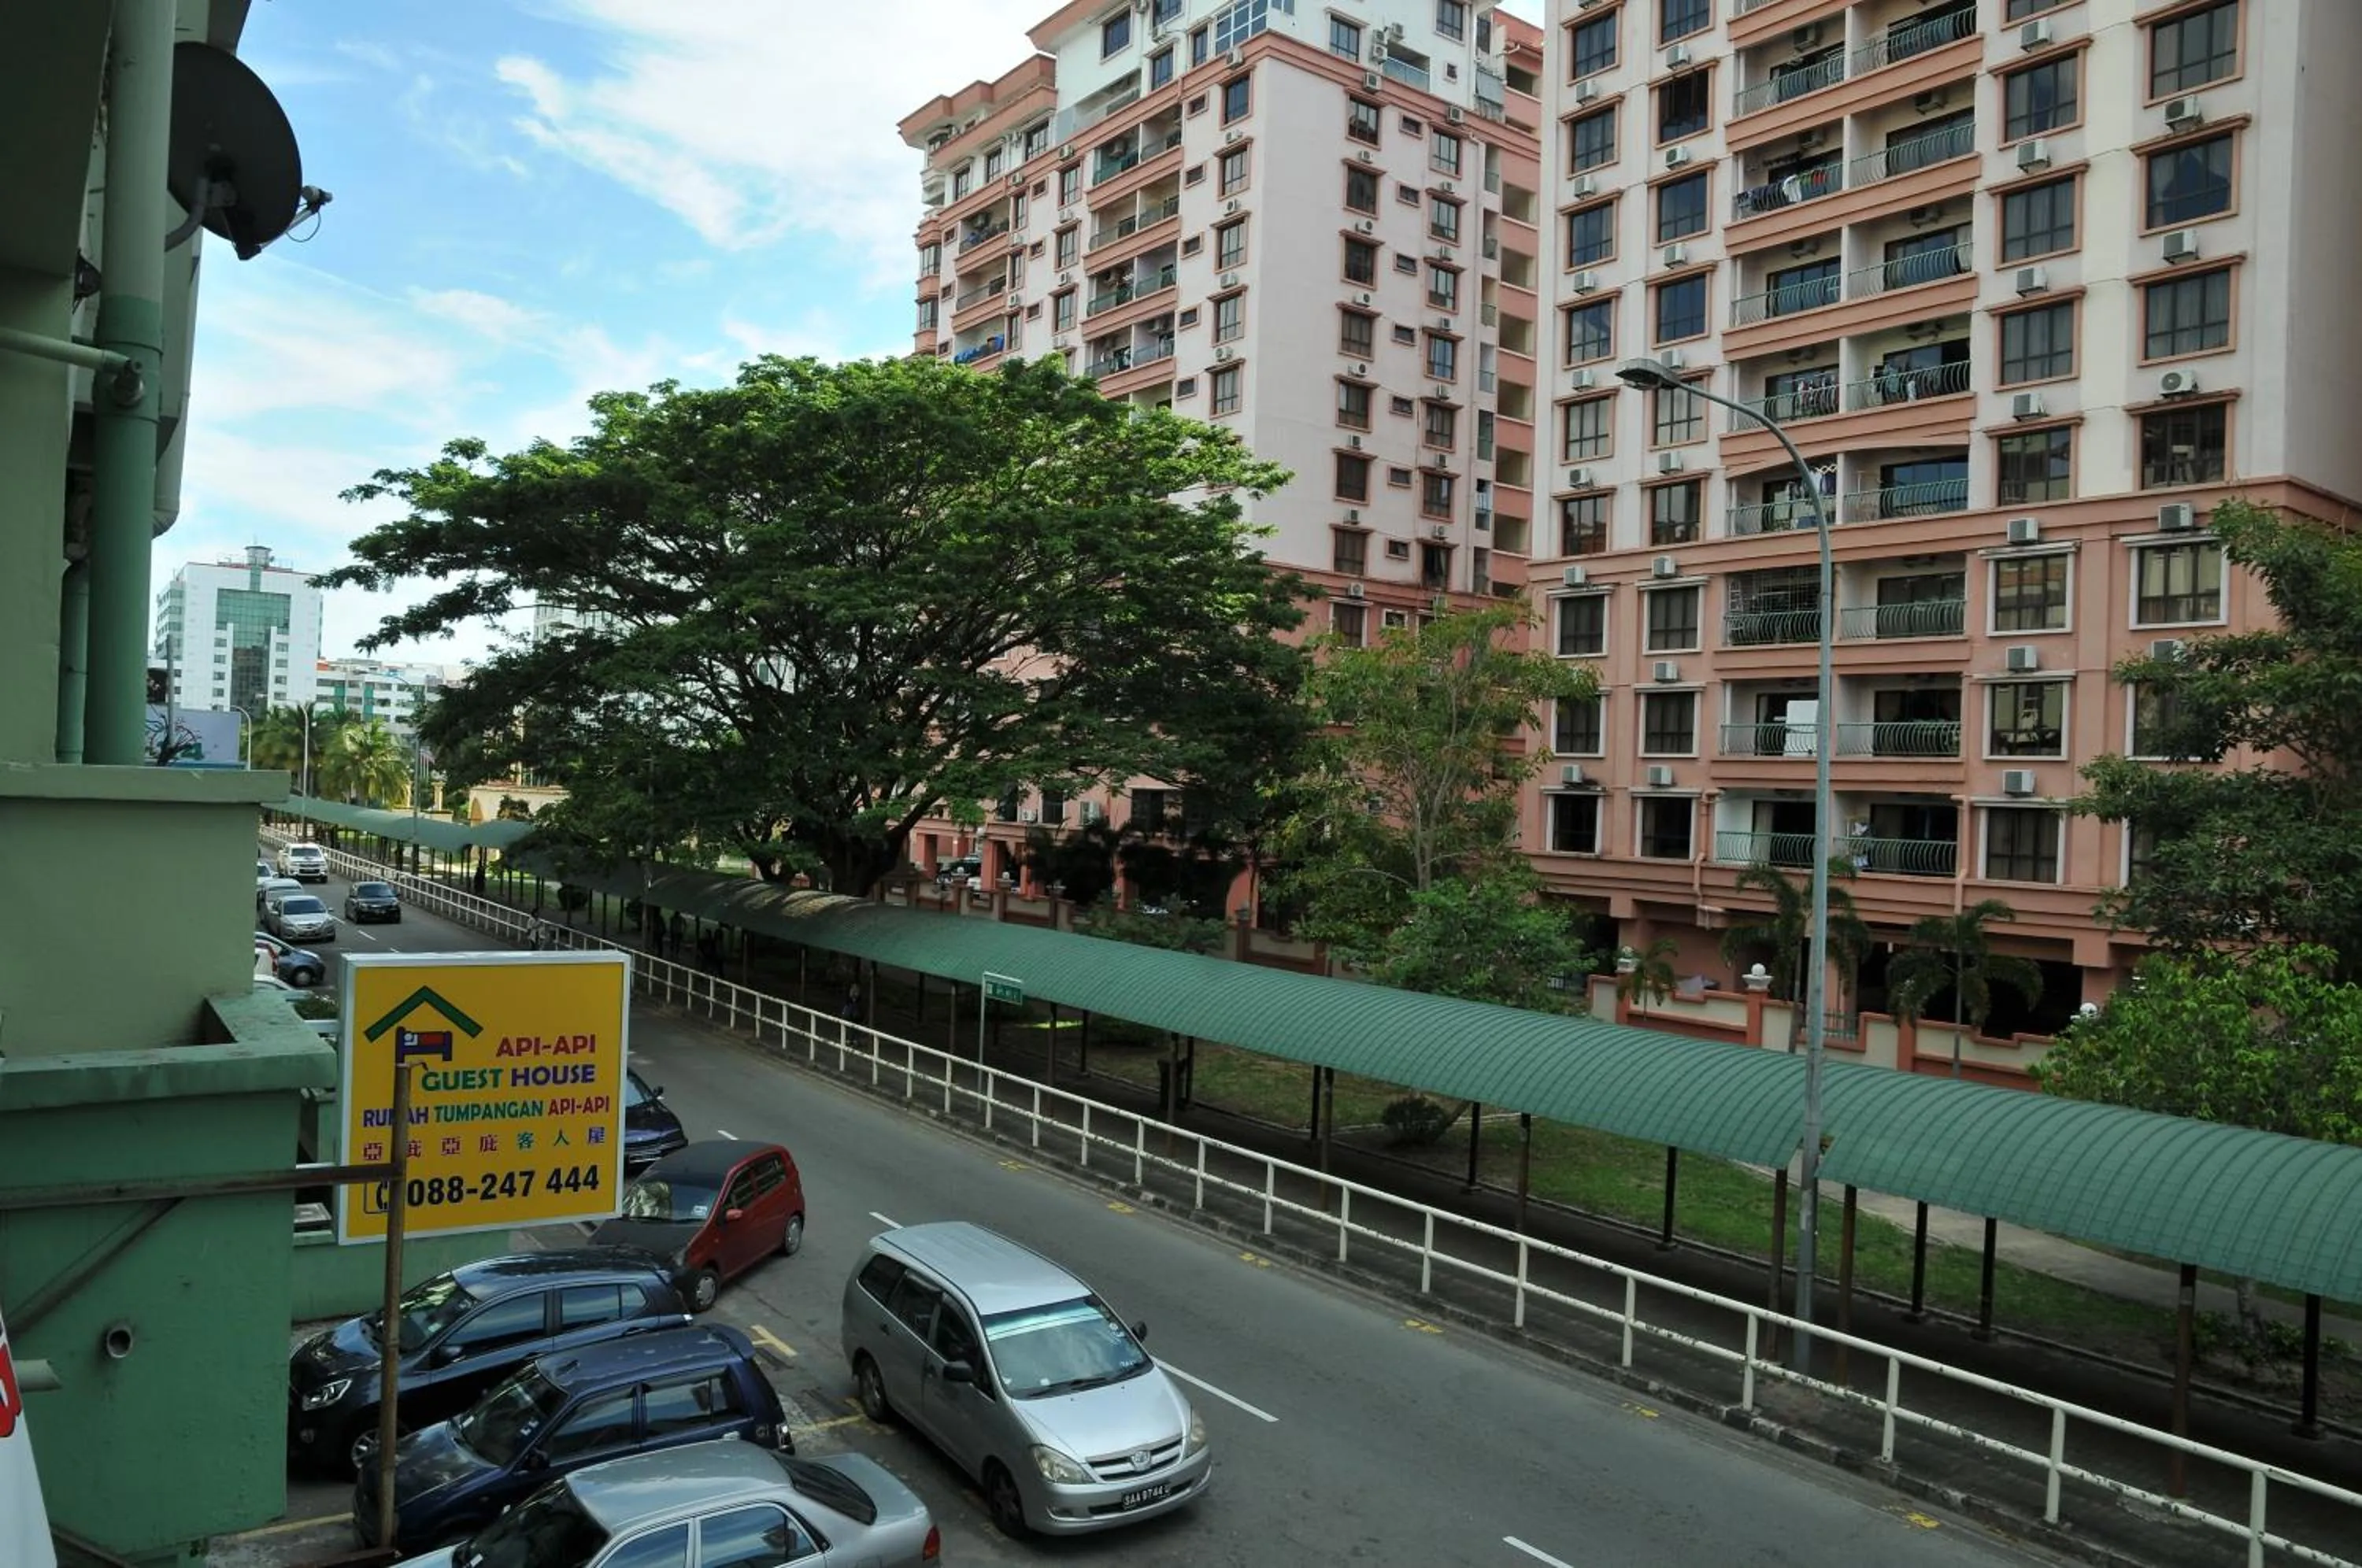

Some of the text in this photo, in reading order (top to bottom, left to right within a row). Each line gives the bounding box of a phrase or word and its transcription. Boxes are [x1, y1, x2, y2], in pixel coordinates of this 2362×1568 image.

[496, 1034, 596, 1058] API-API
[421, 1064, 595, 1092] GUEST HOUSE
[363, 1096, 609, 1127] RUAH TUMPANGAN API-API
[407, 1165, 599, 1207] 088-247 444
